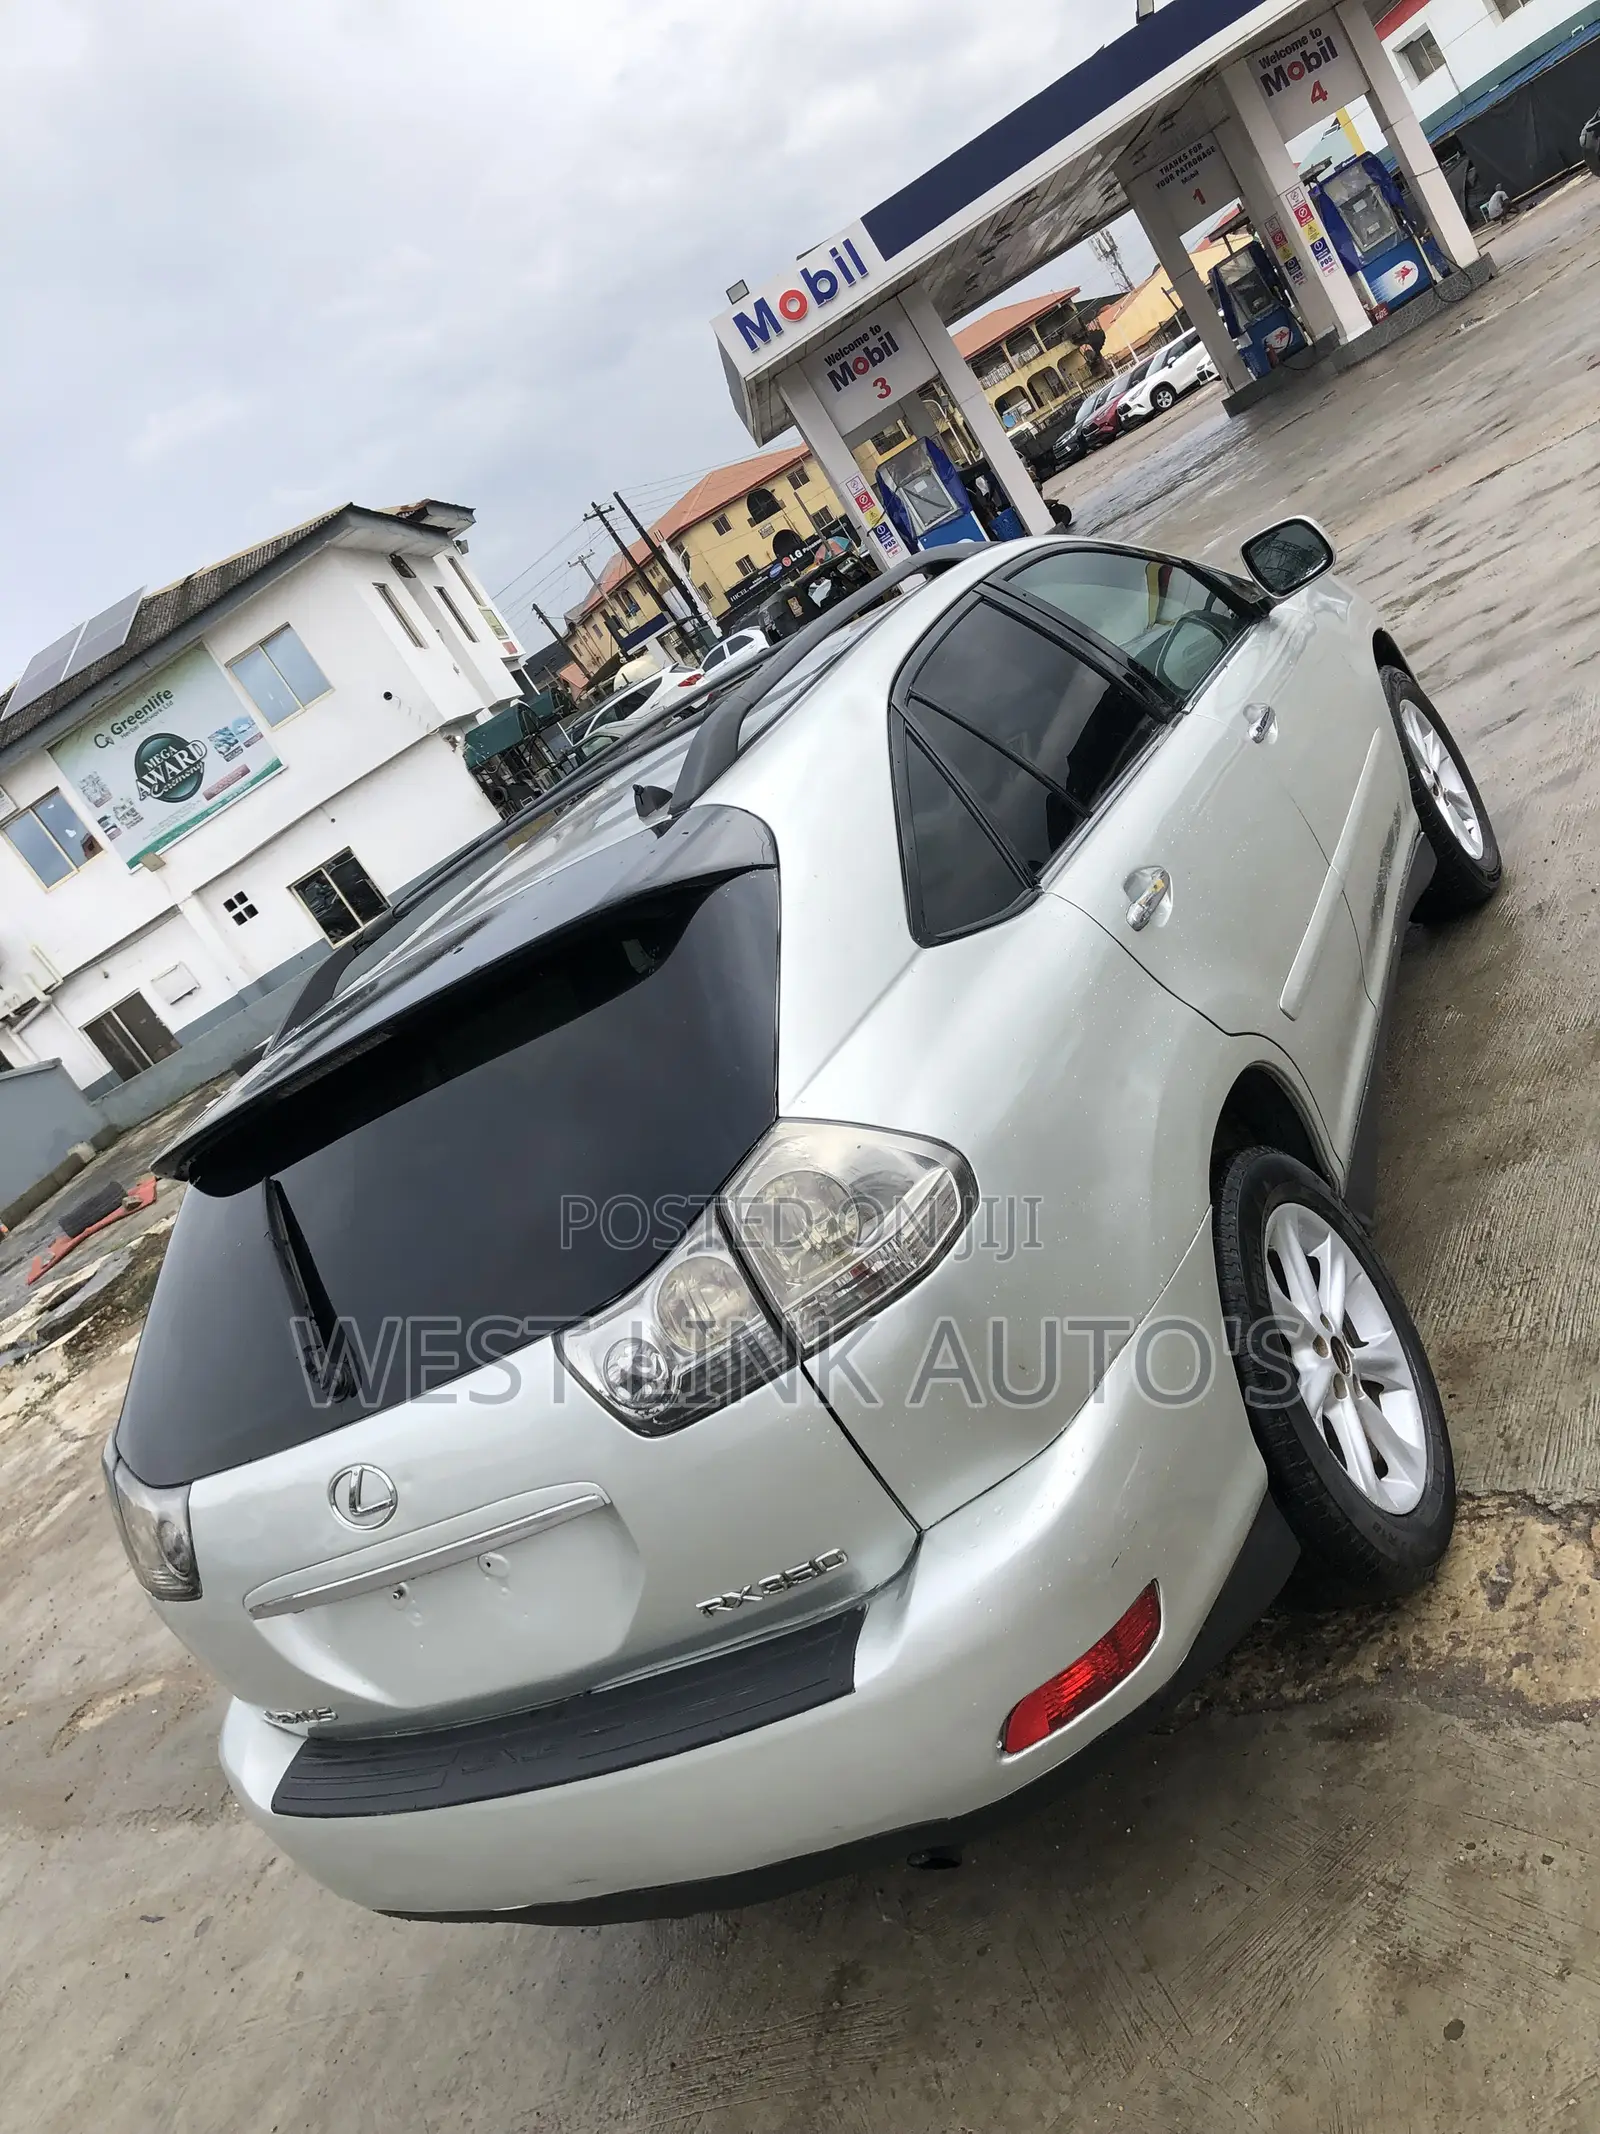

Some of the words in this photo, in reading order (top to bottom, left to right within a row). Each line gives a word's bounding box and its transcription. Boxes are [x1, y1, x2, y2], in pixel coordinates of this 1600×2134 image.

[1258, 35, 1309, 70] Welcome
[1308, 27, 1323, 40] to
[1259, 35, 1339, 98] Mobil
[1310, 80, 1329, 104] 4
[1154, 172, 1176, 190] YOUR
[1174, 145, 1216, 177] PATRONAGE
[1159, 152, 1189, 176] THANKS
[1187, 142, 1204, 157] FOR
[1192, 188, 1206, 206] 1
[731, 237, 869, 353] Mobil
[823, 332, 871, 367] Welcome
[868, 324, 882, 336] to
[826, 330, 900, 393] Mobil
[872, 377, 893, 400] 3
[789, 549, 804, 562] LG
[110, 689, 174, 735] Greenlife
[135, 739, 209, 802] AWARD
[143, 745, 179, 772] MEGA
